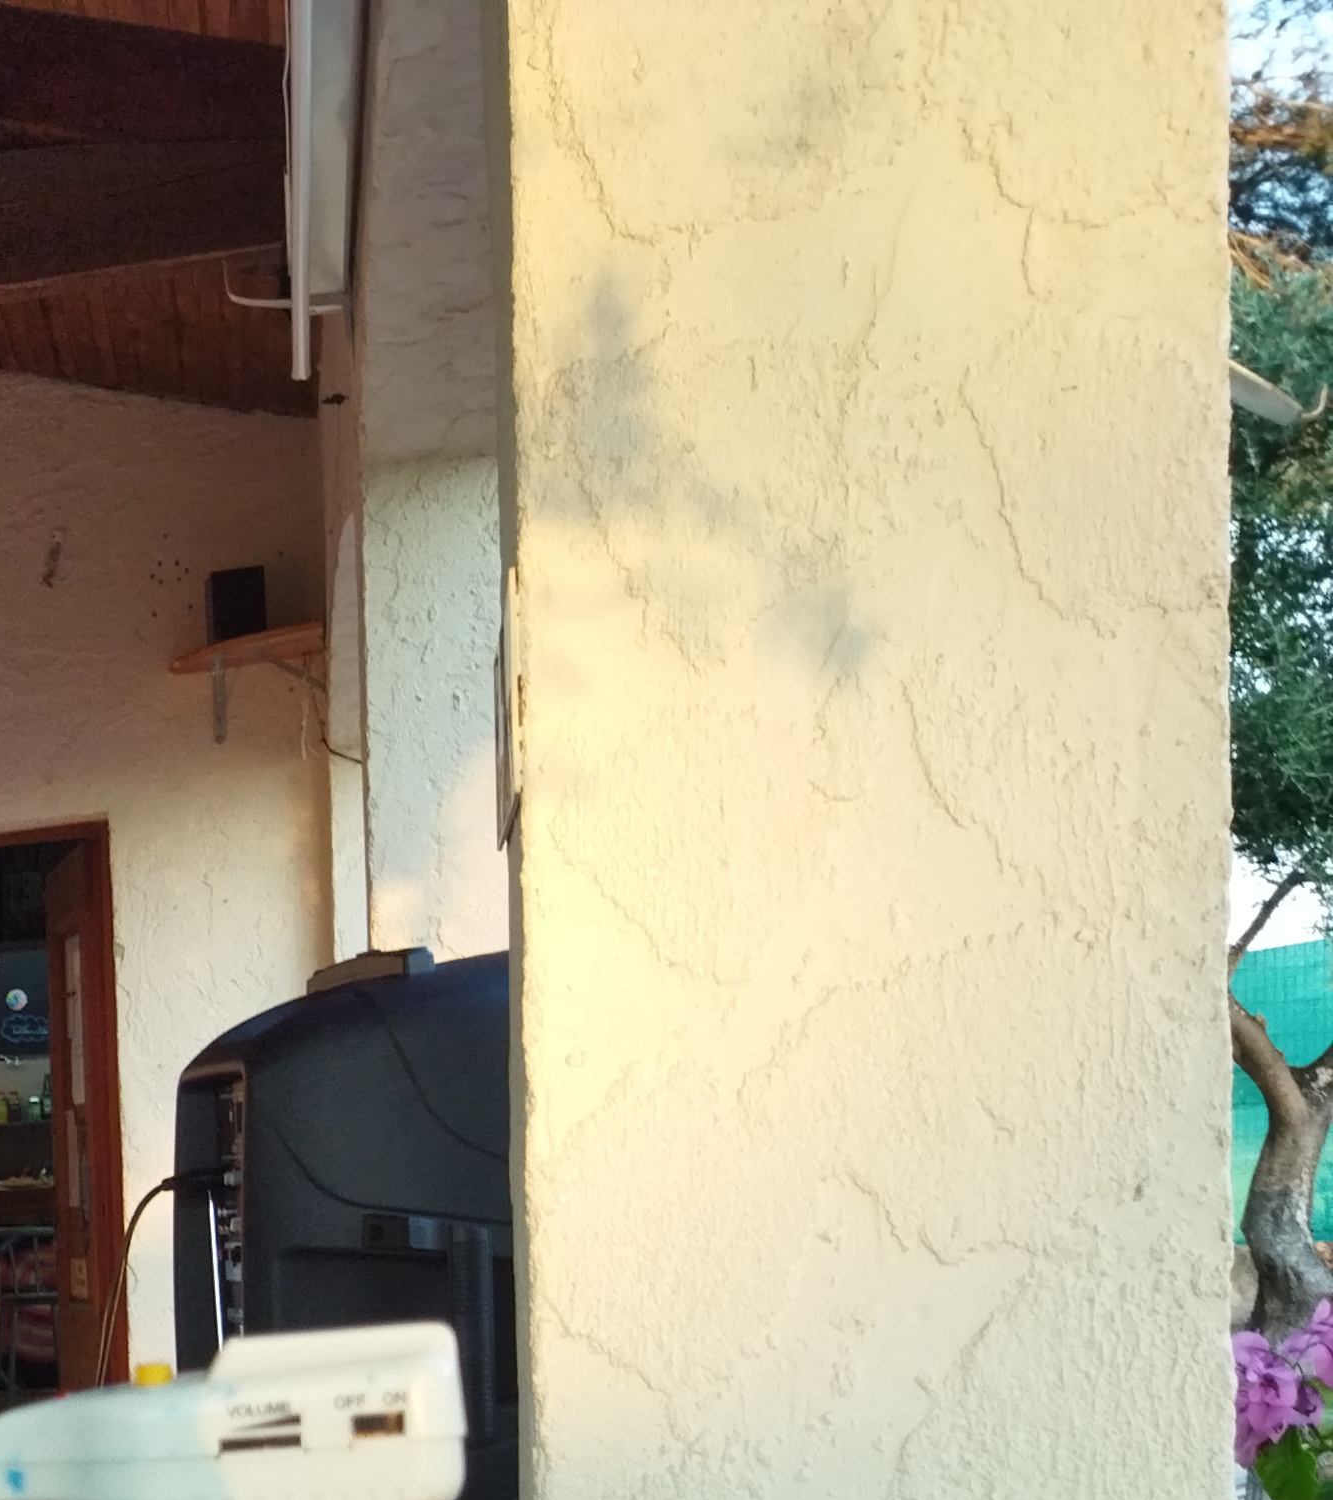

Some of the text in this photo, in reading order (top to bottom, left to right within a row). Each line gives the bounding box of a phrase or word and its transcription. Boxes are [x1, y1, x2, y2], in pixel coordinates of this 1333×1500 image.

[227, 1400, 291, 1418] VOLUME
[334, 1391, 408, 1411] OFF ON
